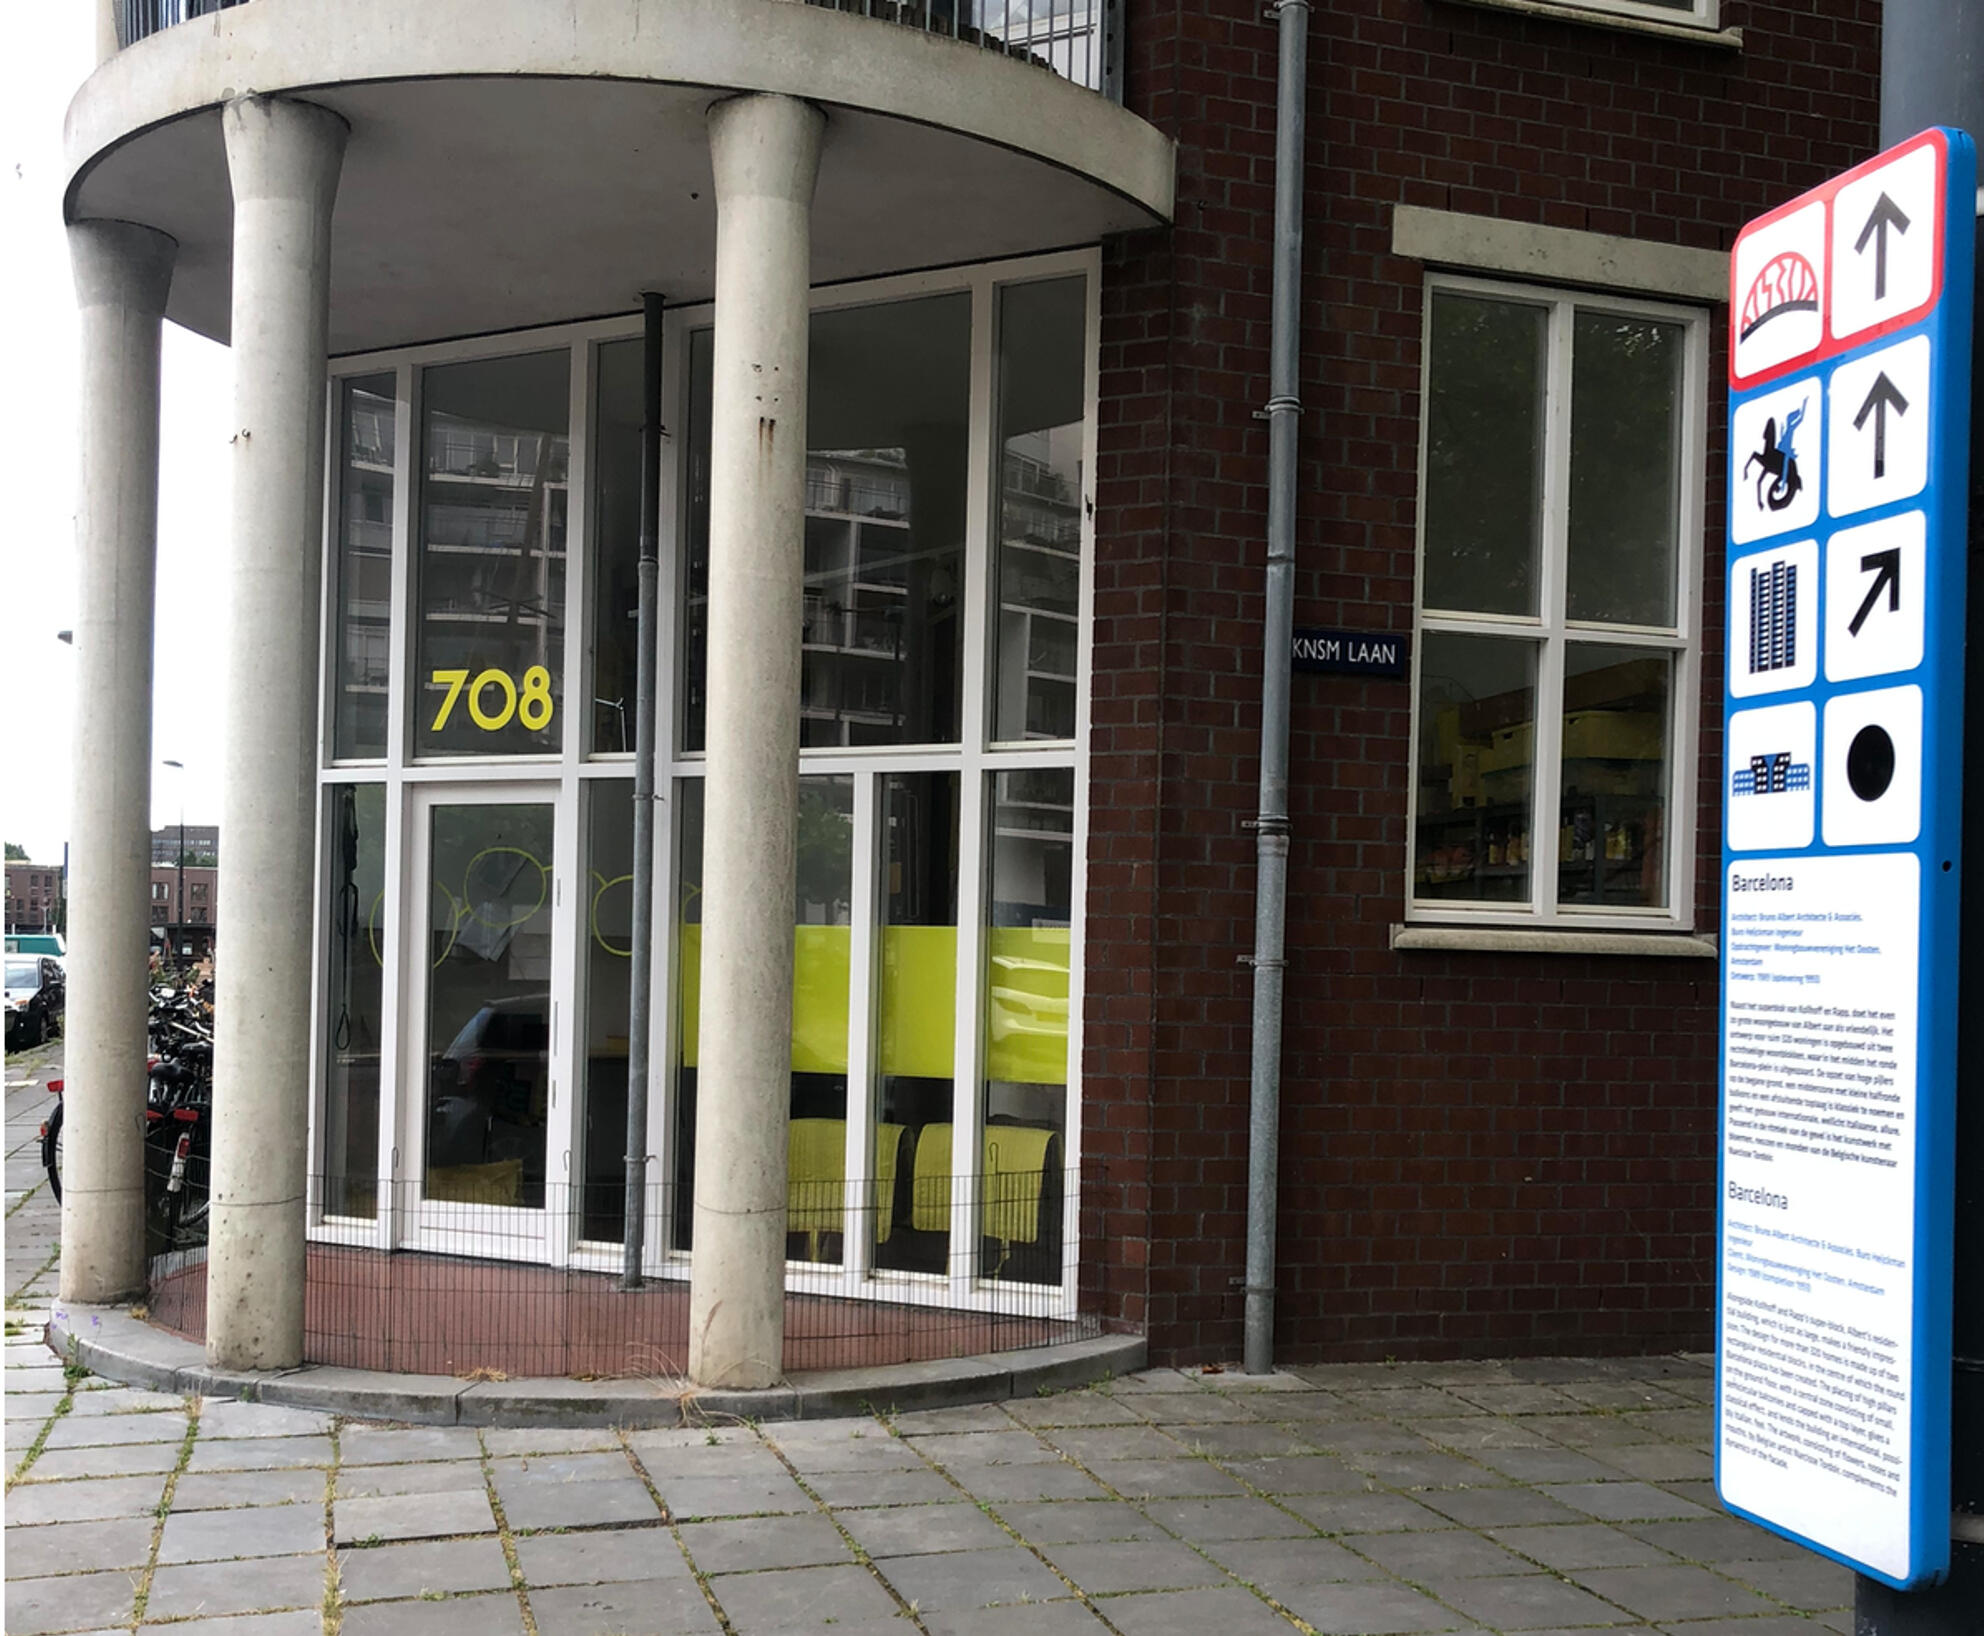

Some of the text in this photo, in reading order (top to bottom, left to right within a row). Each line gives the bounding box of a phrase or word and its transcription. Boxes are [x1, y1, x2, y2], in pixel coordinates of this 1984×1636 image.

[1292, 638, 1396, 665] KNSM LAAN
[431, 664, 554, 731] 708
[1732, 873, 1794, 892] Barcelona
[1728, 1180, 1788, 1210] Barcelona
